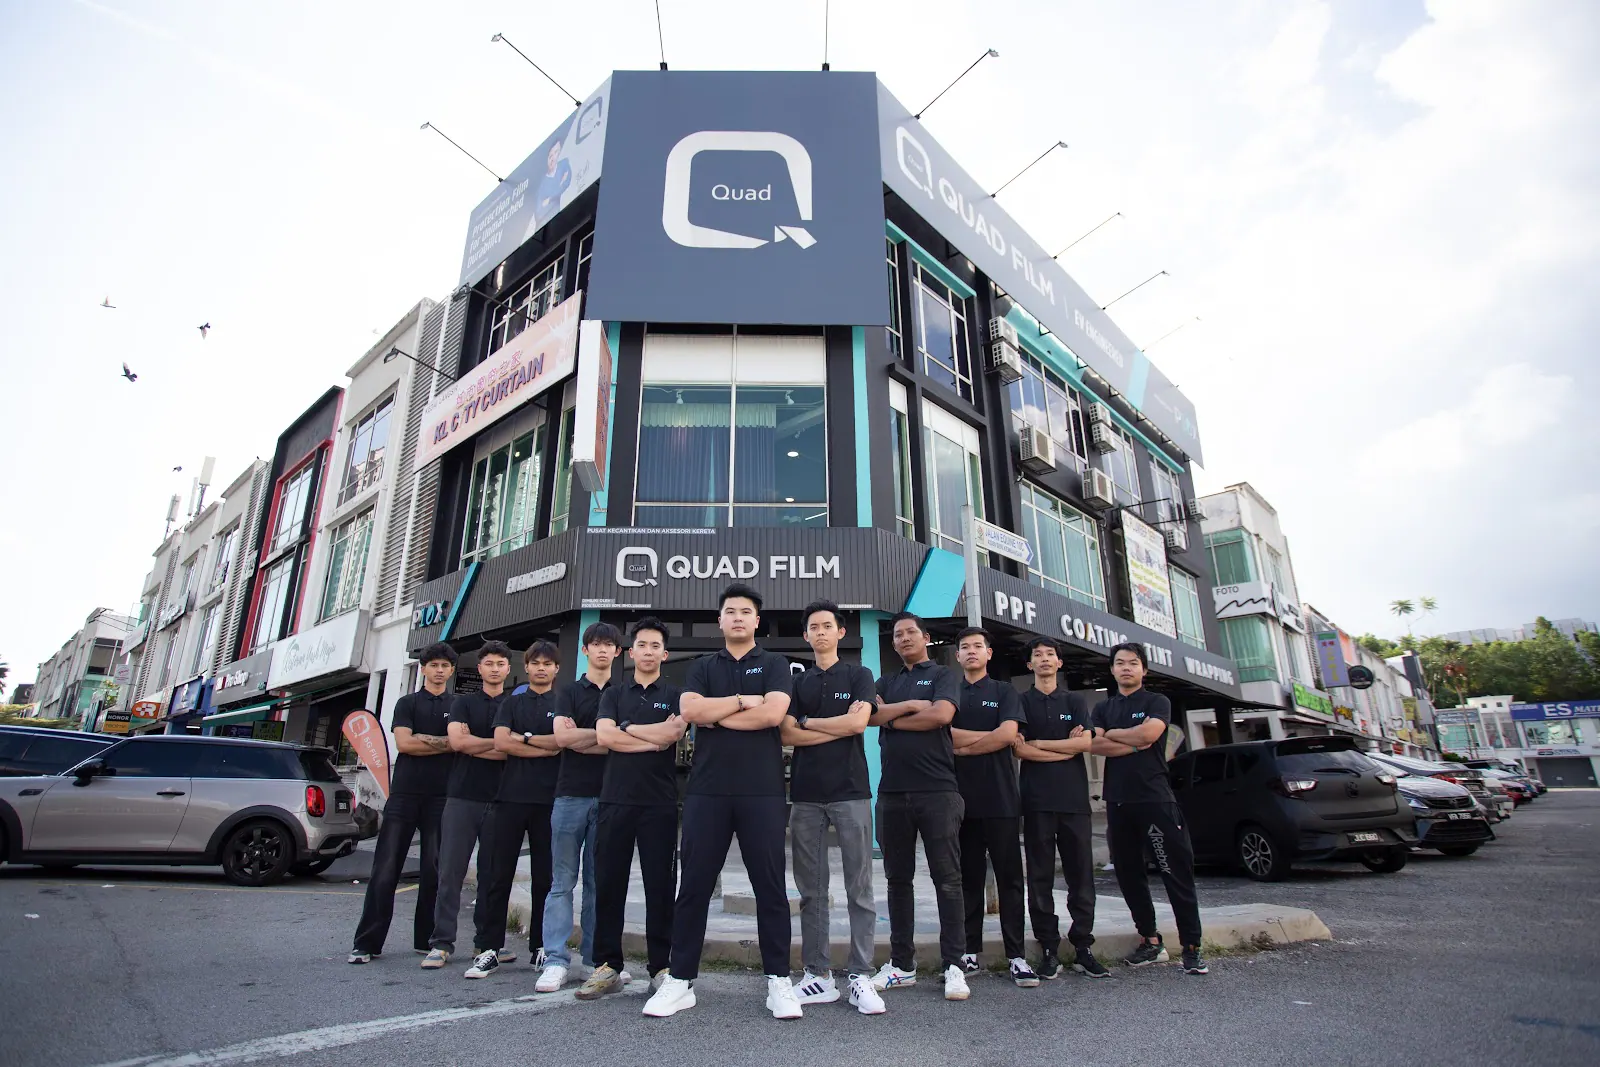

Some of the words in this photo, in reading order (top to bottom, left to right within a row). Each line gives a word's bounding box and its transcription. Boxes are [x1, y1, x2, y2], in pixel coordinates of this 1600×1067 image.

[711, 184, 772, 202] Quad
[938, 177, 1006, 257] QUAD
[1010, 244, 1055, 306] FILM
[433, 419, 449, 445] KL
[480, 352, 545, 412] CURTAIN
[628, 564, 647, 572] Quad
[666, 555, 760, 579] QUAD
[769, 555, 840, 579] FILM
[1216, 585, 1239, 596] FOTO
[994, 590, 1037, 625] PPF
[1142, 642, 1173, 668] TINT
[1183, 656, 1235, 686] WRAPPING
[1542, 703, 1573, 717] ES
[363, 736, 372, 749] 5G
[369, 749, 383, 769] FILM
[1151, 834, 1172, 875] Reebok
